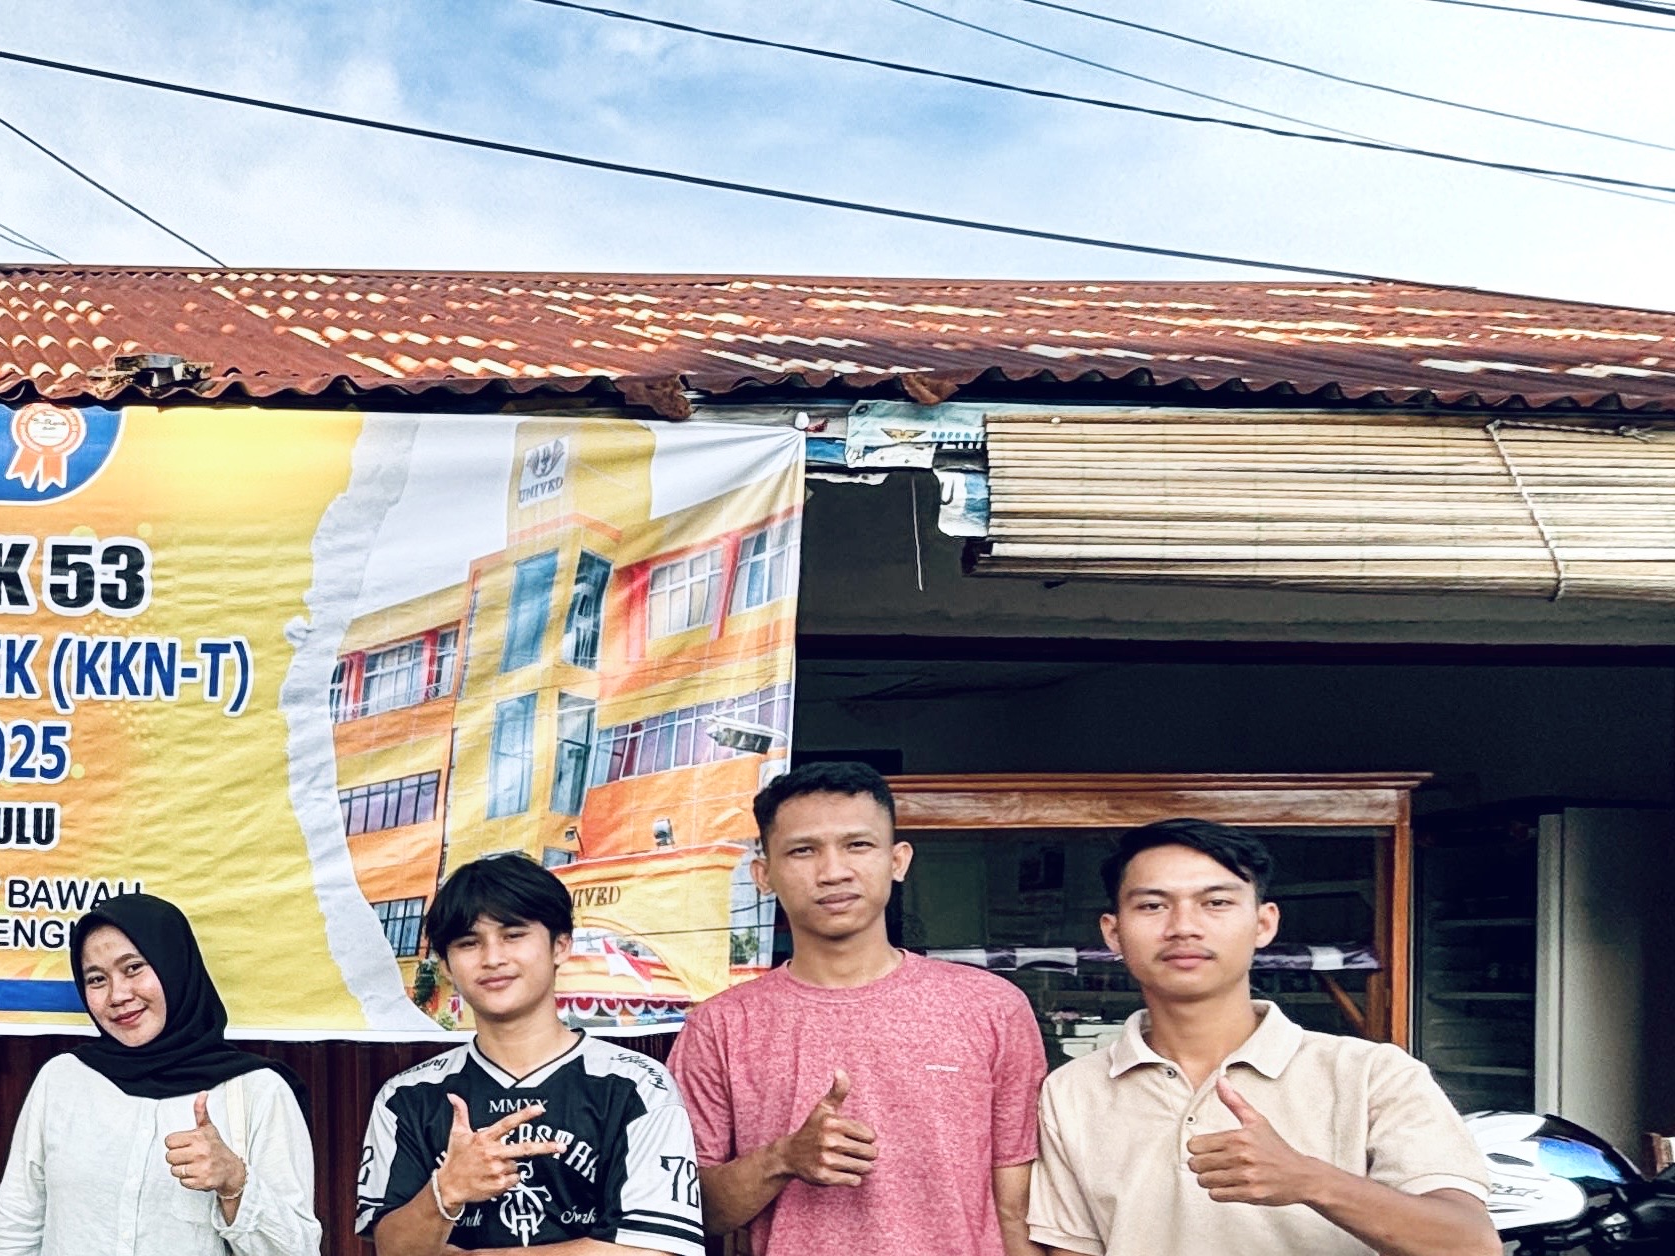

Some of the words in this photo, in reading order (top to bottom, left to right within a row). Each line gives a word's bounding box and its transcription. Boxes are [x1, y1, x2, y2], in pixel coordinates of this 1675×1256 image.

[49, 544, 146, 610] 53
[52, 637, 250, 713] (KKN-T)
[571, 885, 622, 908] IVED
